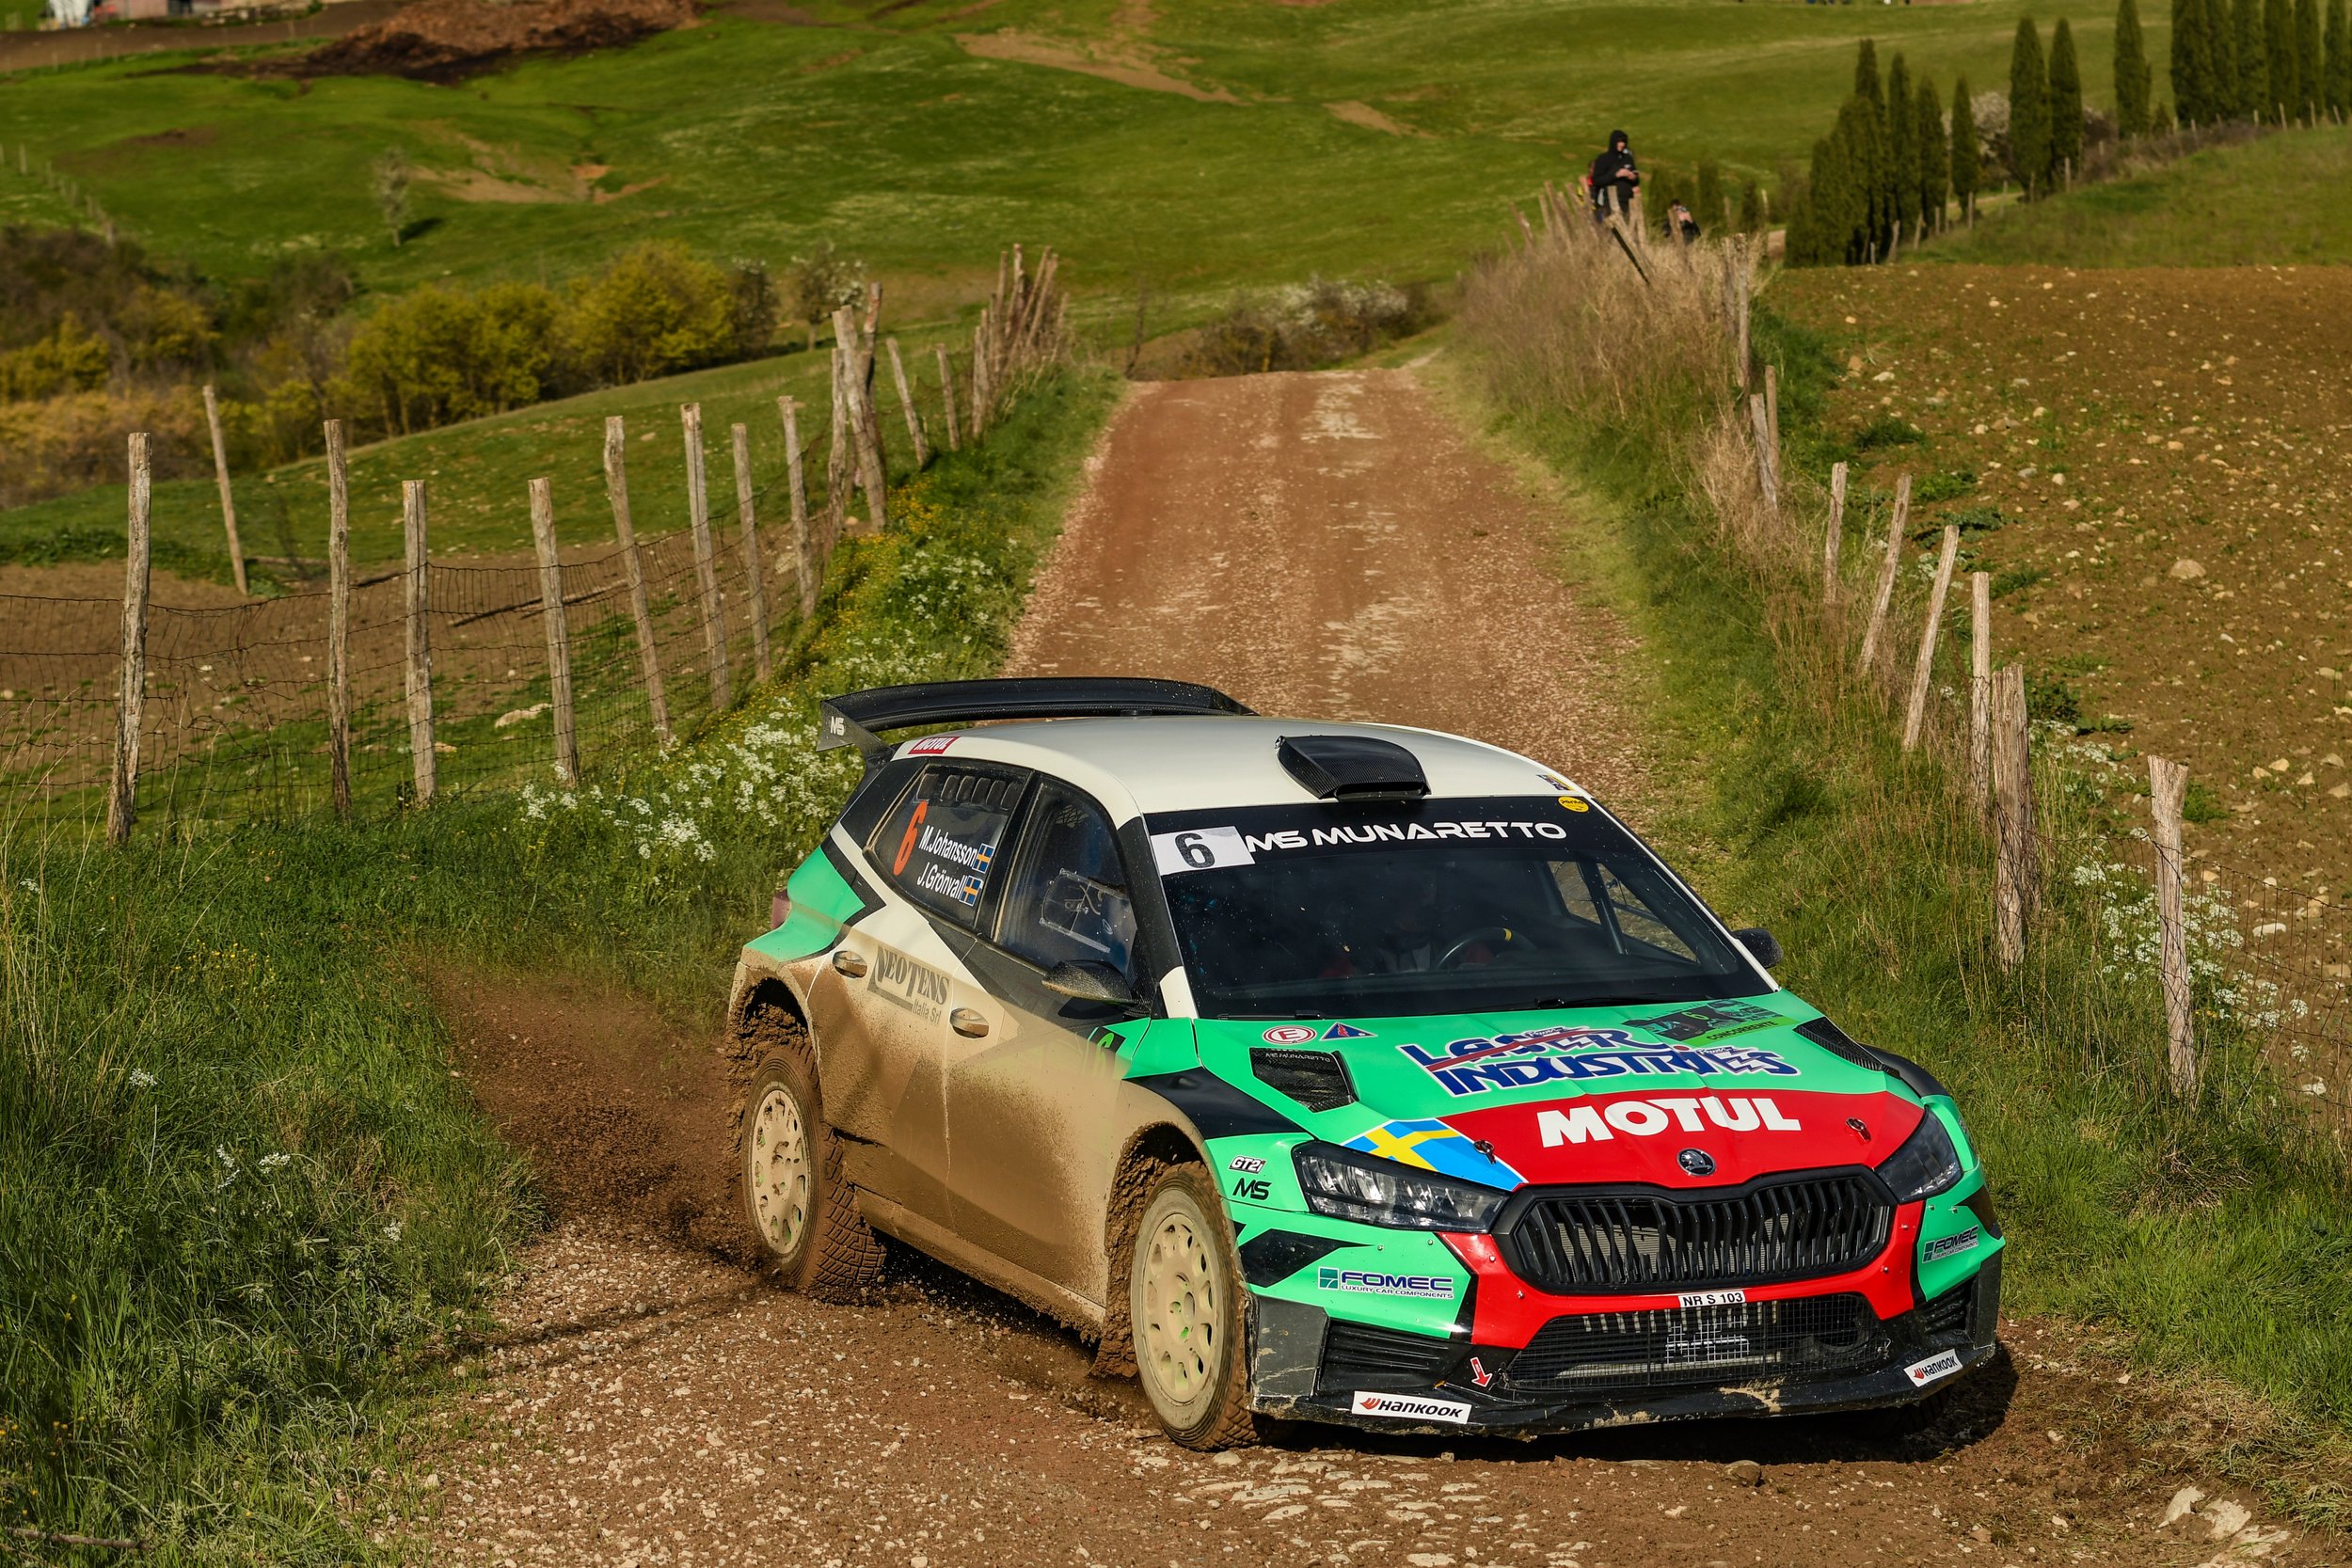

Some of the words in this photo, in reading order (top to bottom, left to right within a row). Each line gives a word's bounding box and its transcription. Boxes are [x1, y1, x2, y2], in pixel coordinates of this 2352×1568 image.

[893, 800, 928, 877] 6
[918, 825, 978, 867] M.Johansson
[1175, 832, 1216, 869] 6
[1245, 829, 1309, 853] MS
[1312, 820, 1567, 847] MUNARETTO
[916, 862, 969, 900] J.Grönvall
[1399, 1029, 1671, 1068] LASER
[1432, 1046, 1799, 1096] INDUSTRIES
[1536, 1096, 1802, 1148] MOTUL
[1232, 1177, 1272, 1201] MS
[1934, 1226, 1979, 1253] FOMEC
[1341, 1272, 1453, 1291] FOMEC
[1341, 1285, 1375, 1293] LUXURY
[1395, 1290, 1454, 1299] COMPONENTS
[1683, 1295, 1704, 1307] NR
[1708, 1294, 1717, 1305] S
[1720, 1292, 1744, 1304] 103
